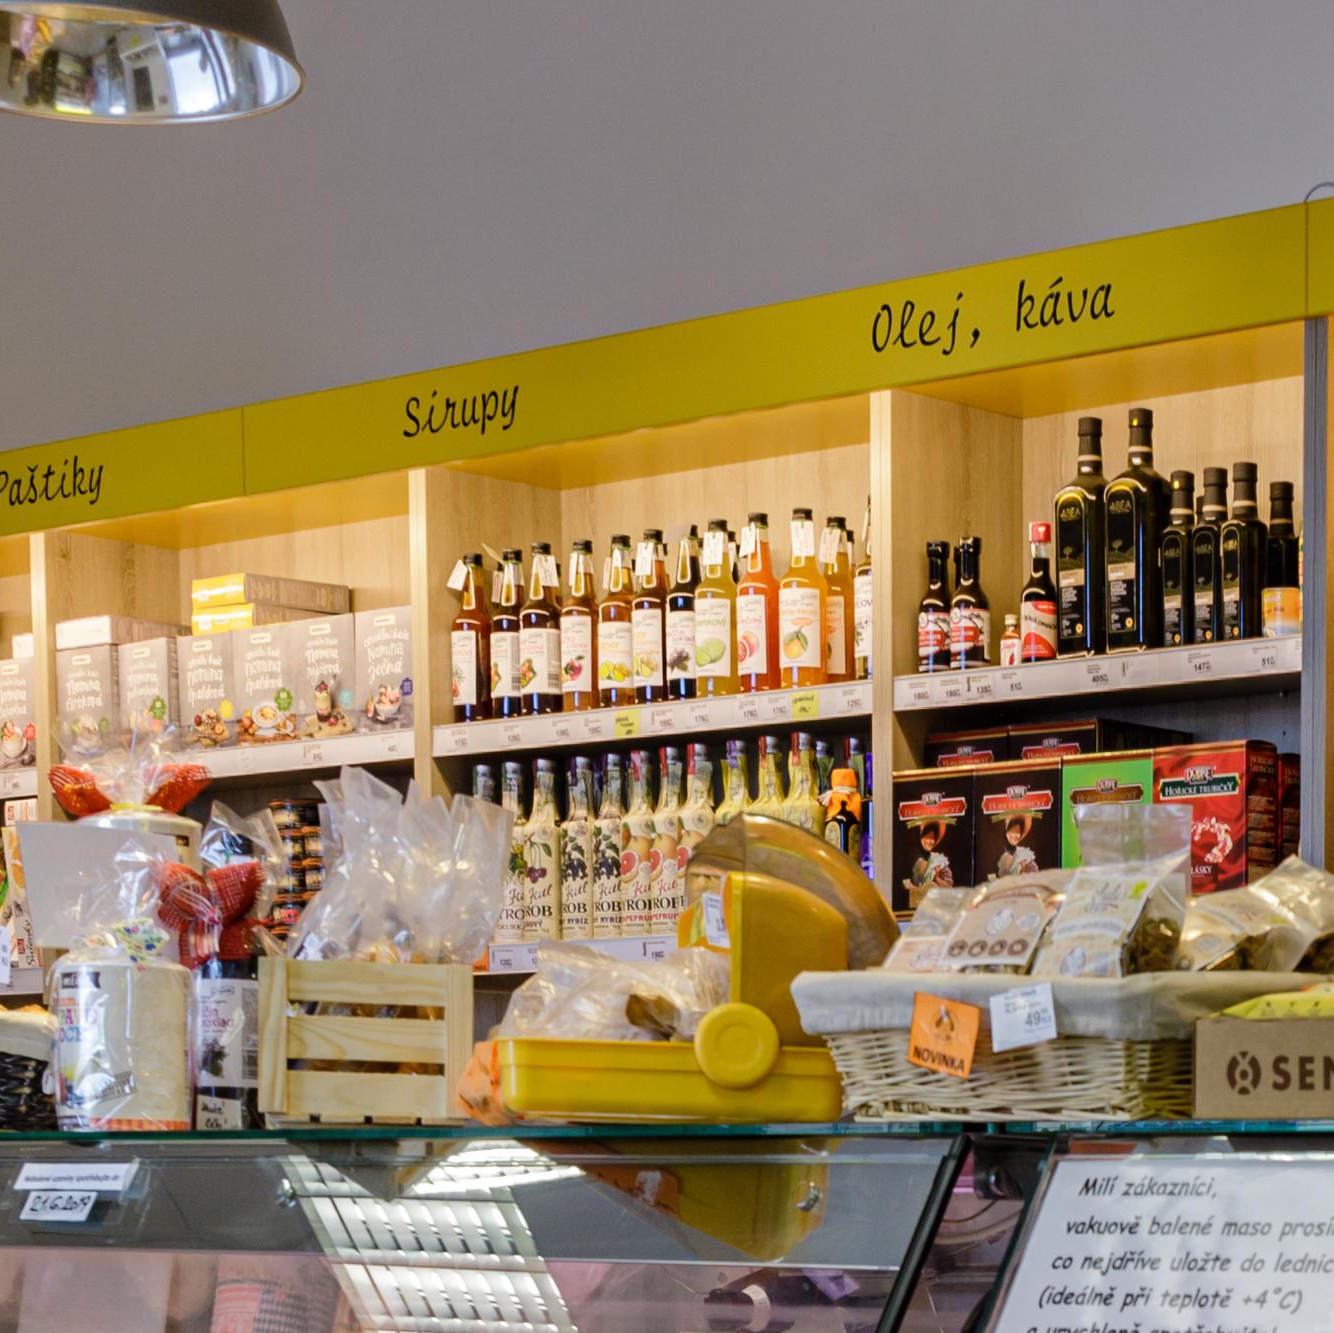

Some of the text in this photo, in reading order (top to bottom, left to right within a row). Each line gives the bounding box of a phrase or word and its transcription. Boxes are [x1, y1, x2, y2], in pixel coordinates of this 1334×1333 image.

[872, 276, 1116, 356] Olej, káva
[632, 881, 651, 898] Kit
[1024, 1010, 1042, 1028] 49
[912, 1044, 967, 1072] NOVINKA
[1078, 1176, 1218, 1199] Milí zákazníci,
[1066, 1216, 1141, 1238] vakuově
[1148, 1215, 1213, 1238] balené
[1220, 1220, 1272, 1238] maso
[1050, 1256, 1073, 1271] co
[1080, 1250, 1161, 1277] nejdříve
[1169, 1251, 1232, 1273] uložte
[1239, 1252, 1265, 1274] do
[1037, 1285, 1118, 1310] (ideálně
[1121, 1286, 1150, 1313] při
[1159, 1286, 1231, 1315] teplotě
